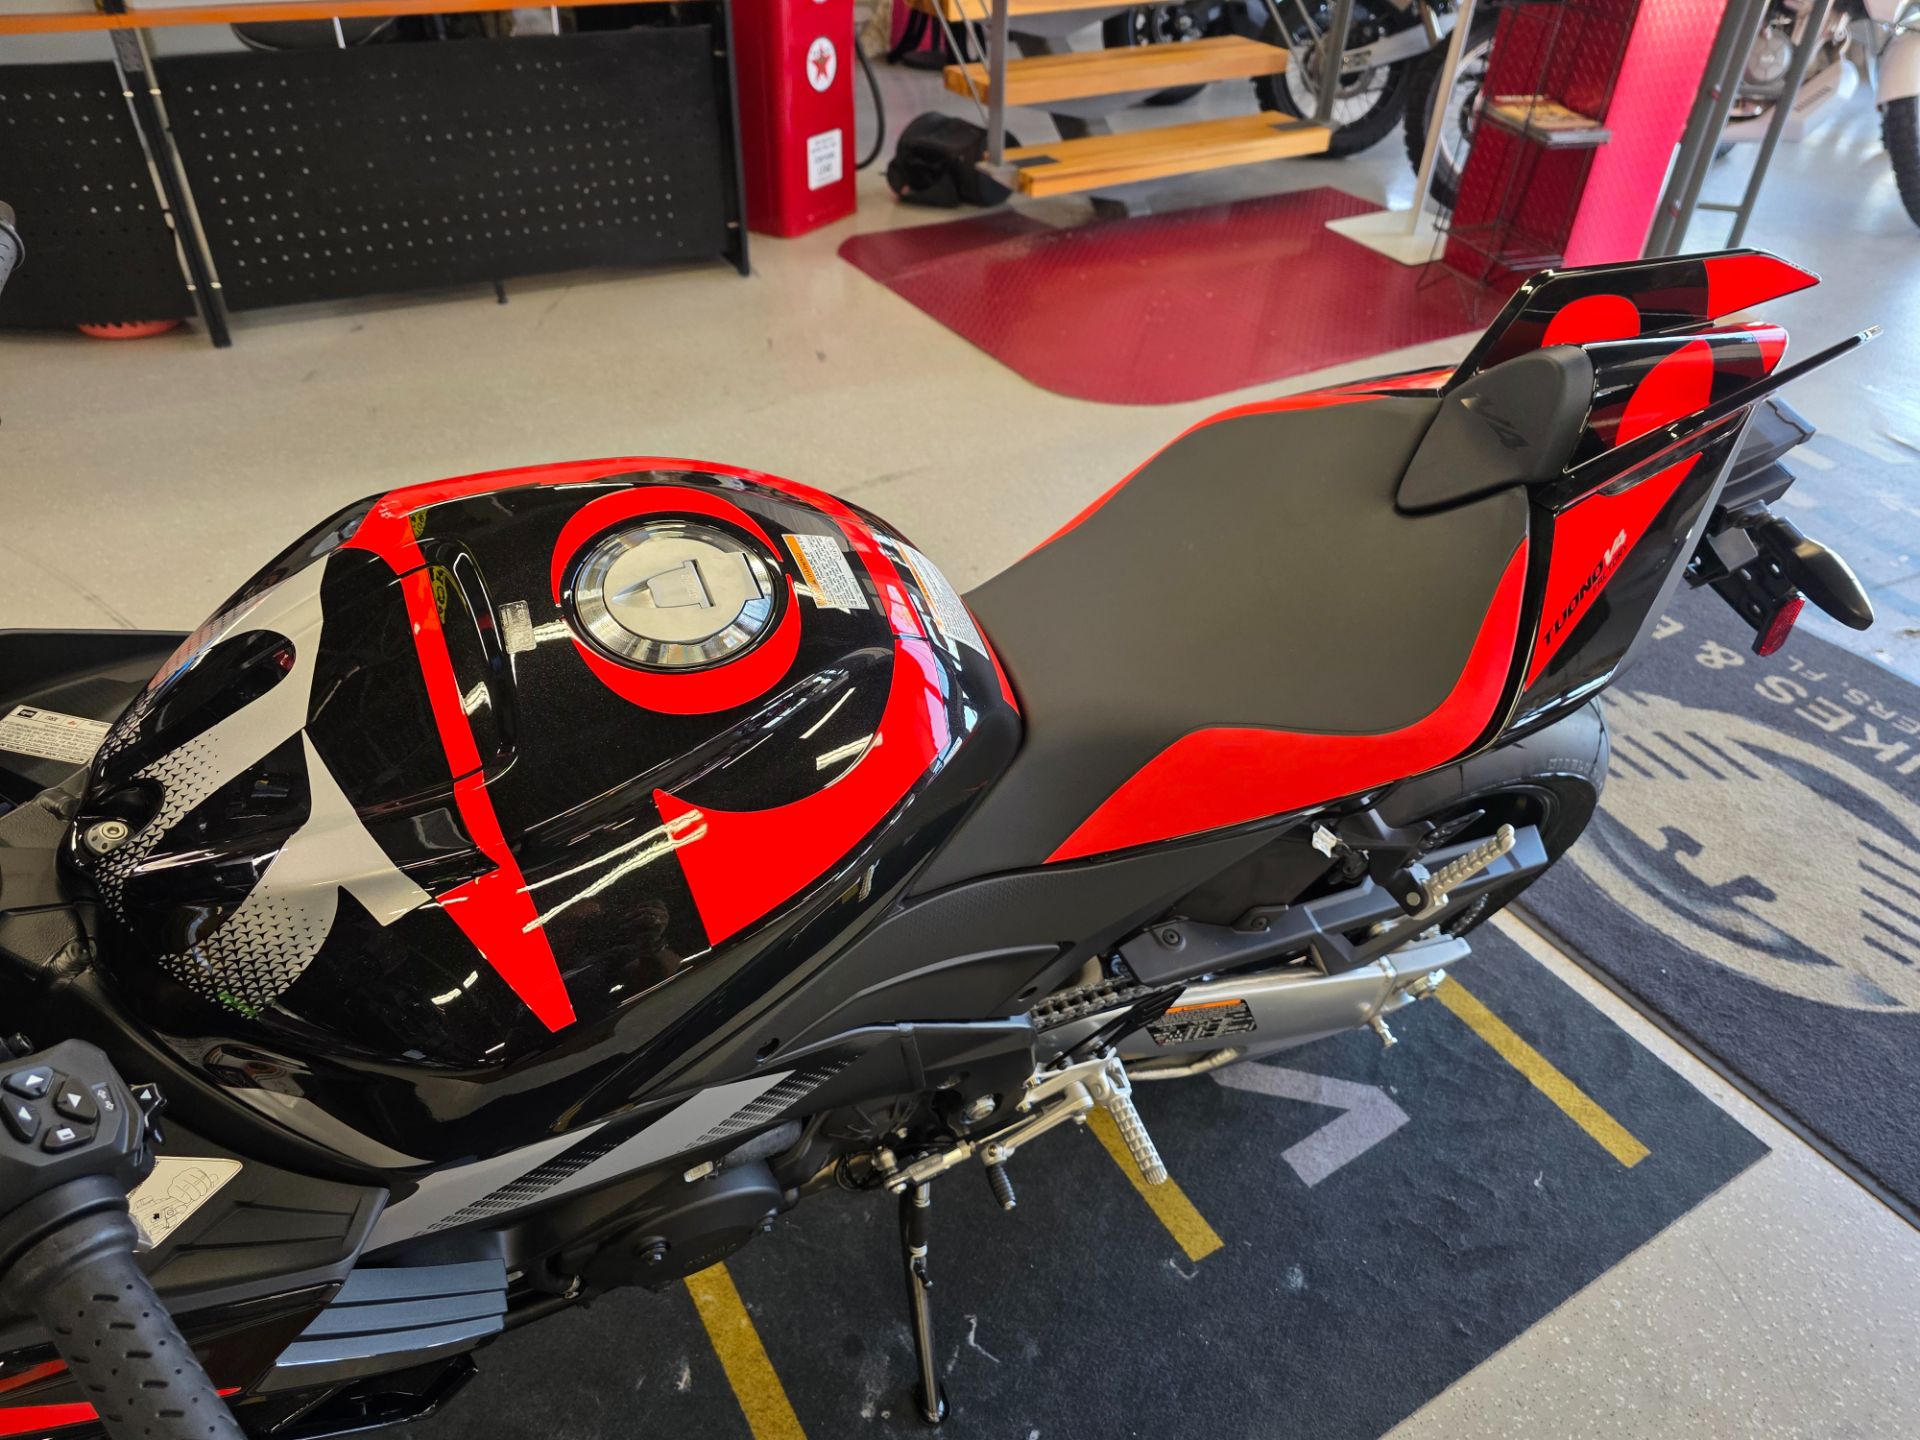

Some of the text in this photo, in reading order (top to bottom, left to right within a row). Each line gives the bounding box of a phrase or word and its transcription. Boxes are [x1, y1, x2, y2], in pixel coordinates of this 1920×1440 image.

[1545, 528, 1627, 645] TUONO V4
[1695, 640, 1745, 670] &
[1788, 655, 1920, 739] ERS, FL
